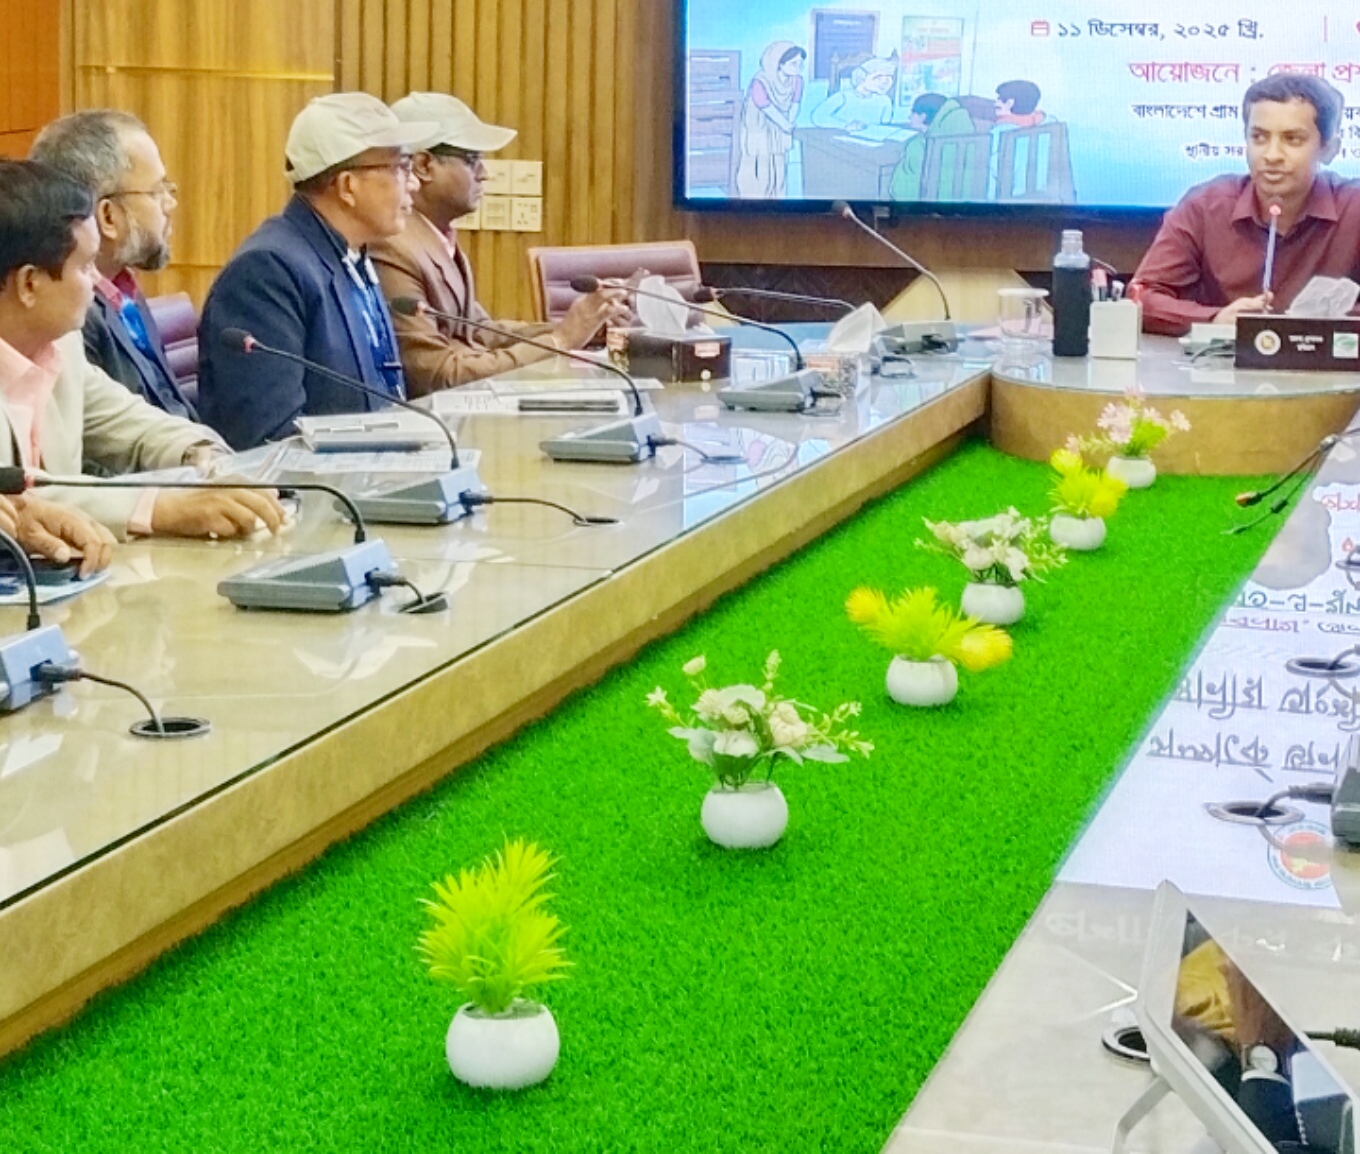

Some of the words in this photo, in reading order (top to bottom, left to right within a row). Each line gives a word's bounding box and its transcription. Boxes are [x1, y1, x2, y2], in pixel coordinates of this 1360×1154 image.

[1058, 22, 1082, 37] ১১
[1088, 18, 1165, 41] ডিসেম্বর,
[1174, 22, 1231, 38] ২০২৫
[1128, 61, 1240, 84] আয়োজনে
